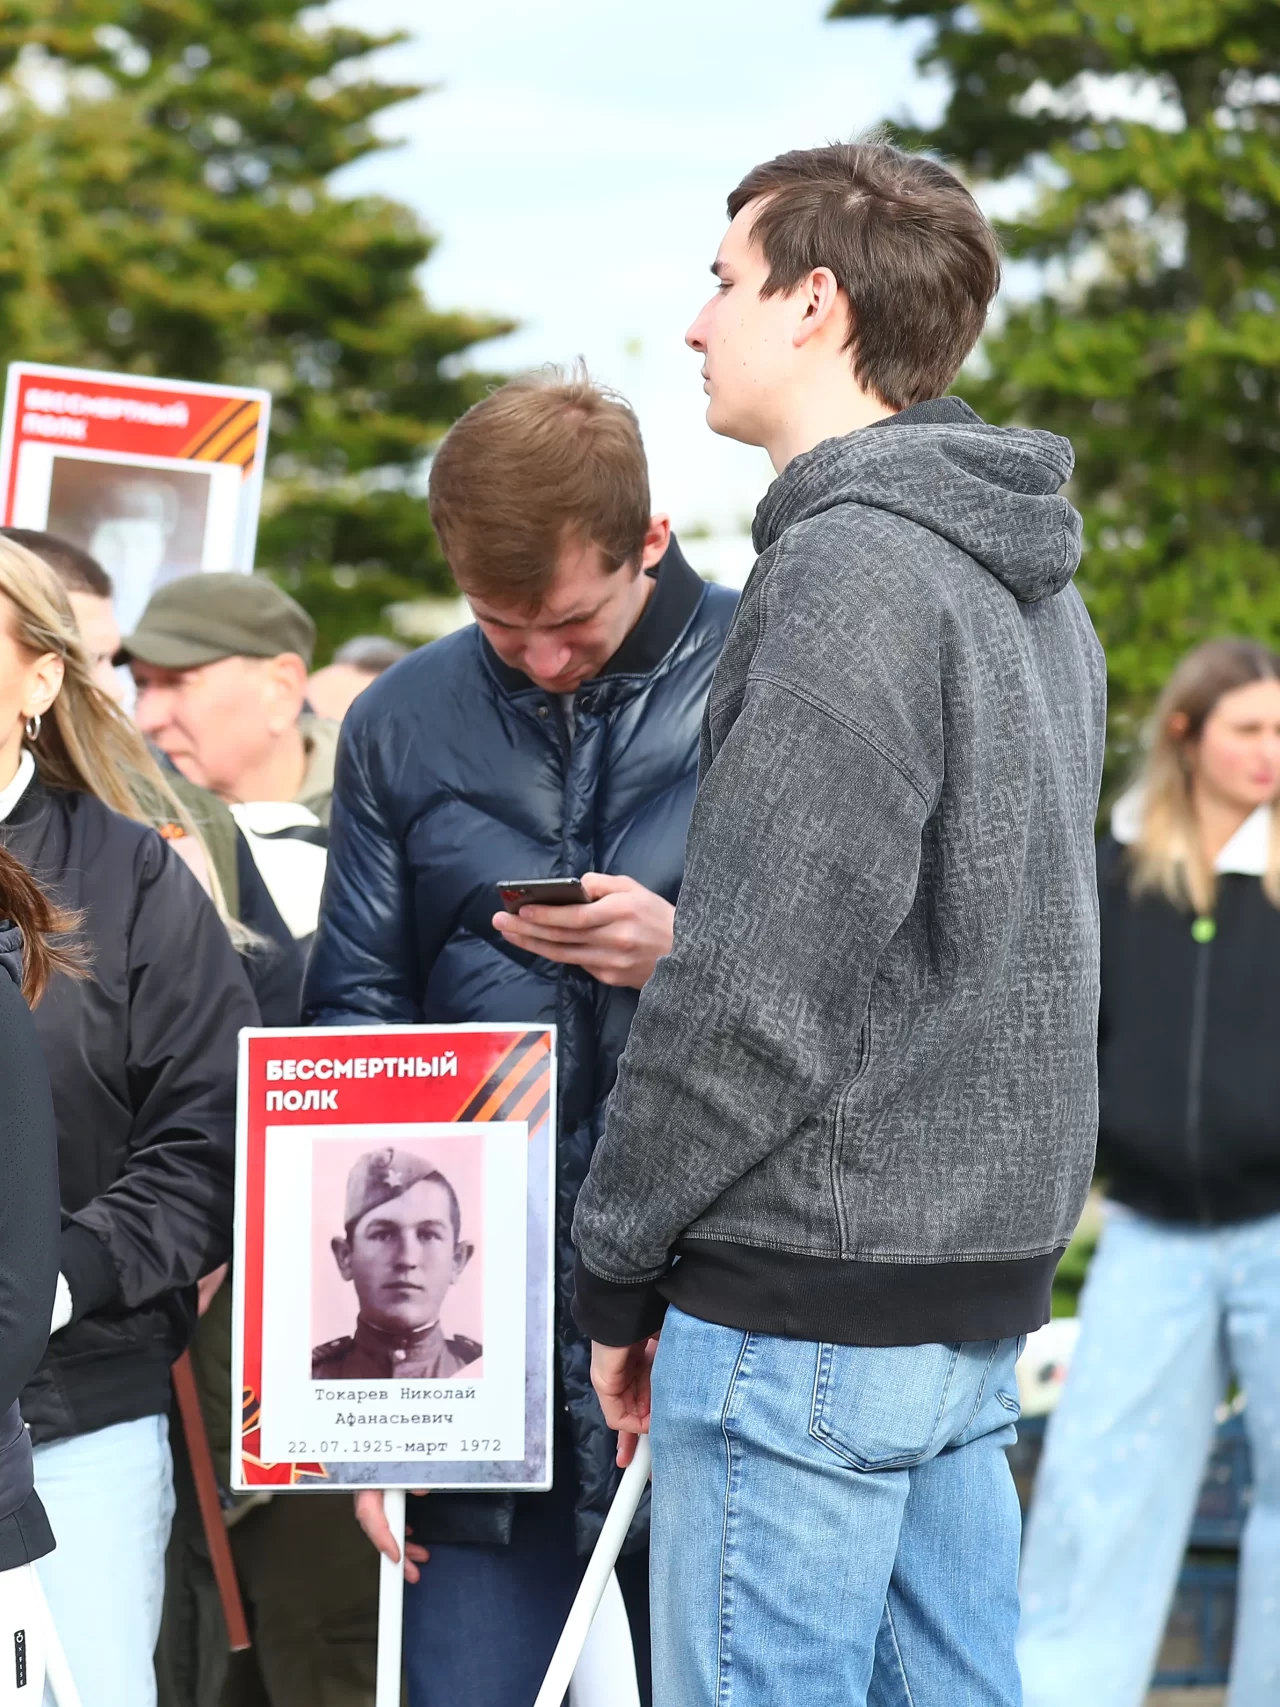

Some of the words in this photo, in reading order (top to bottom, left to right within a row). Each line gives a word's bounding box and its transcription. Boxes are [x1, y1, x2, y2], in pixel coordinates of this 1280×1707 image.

[266, 1051, 458, 1081] БЕССМЕРТНЫЙ
[265, 1088, 339, 1112] ПОЛК
[315, 1388, 389, 1403] Токарев
[400, 1385, 476, 1400] Николай
[335, 1412, 454, 1427] Афанасьевич
[288, 1440, 449, 1456] 22.07.1925-март
[460, 1439, 502, 1452] 1972
